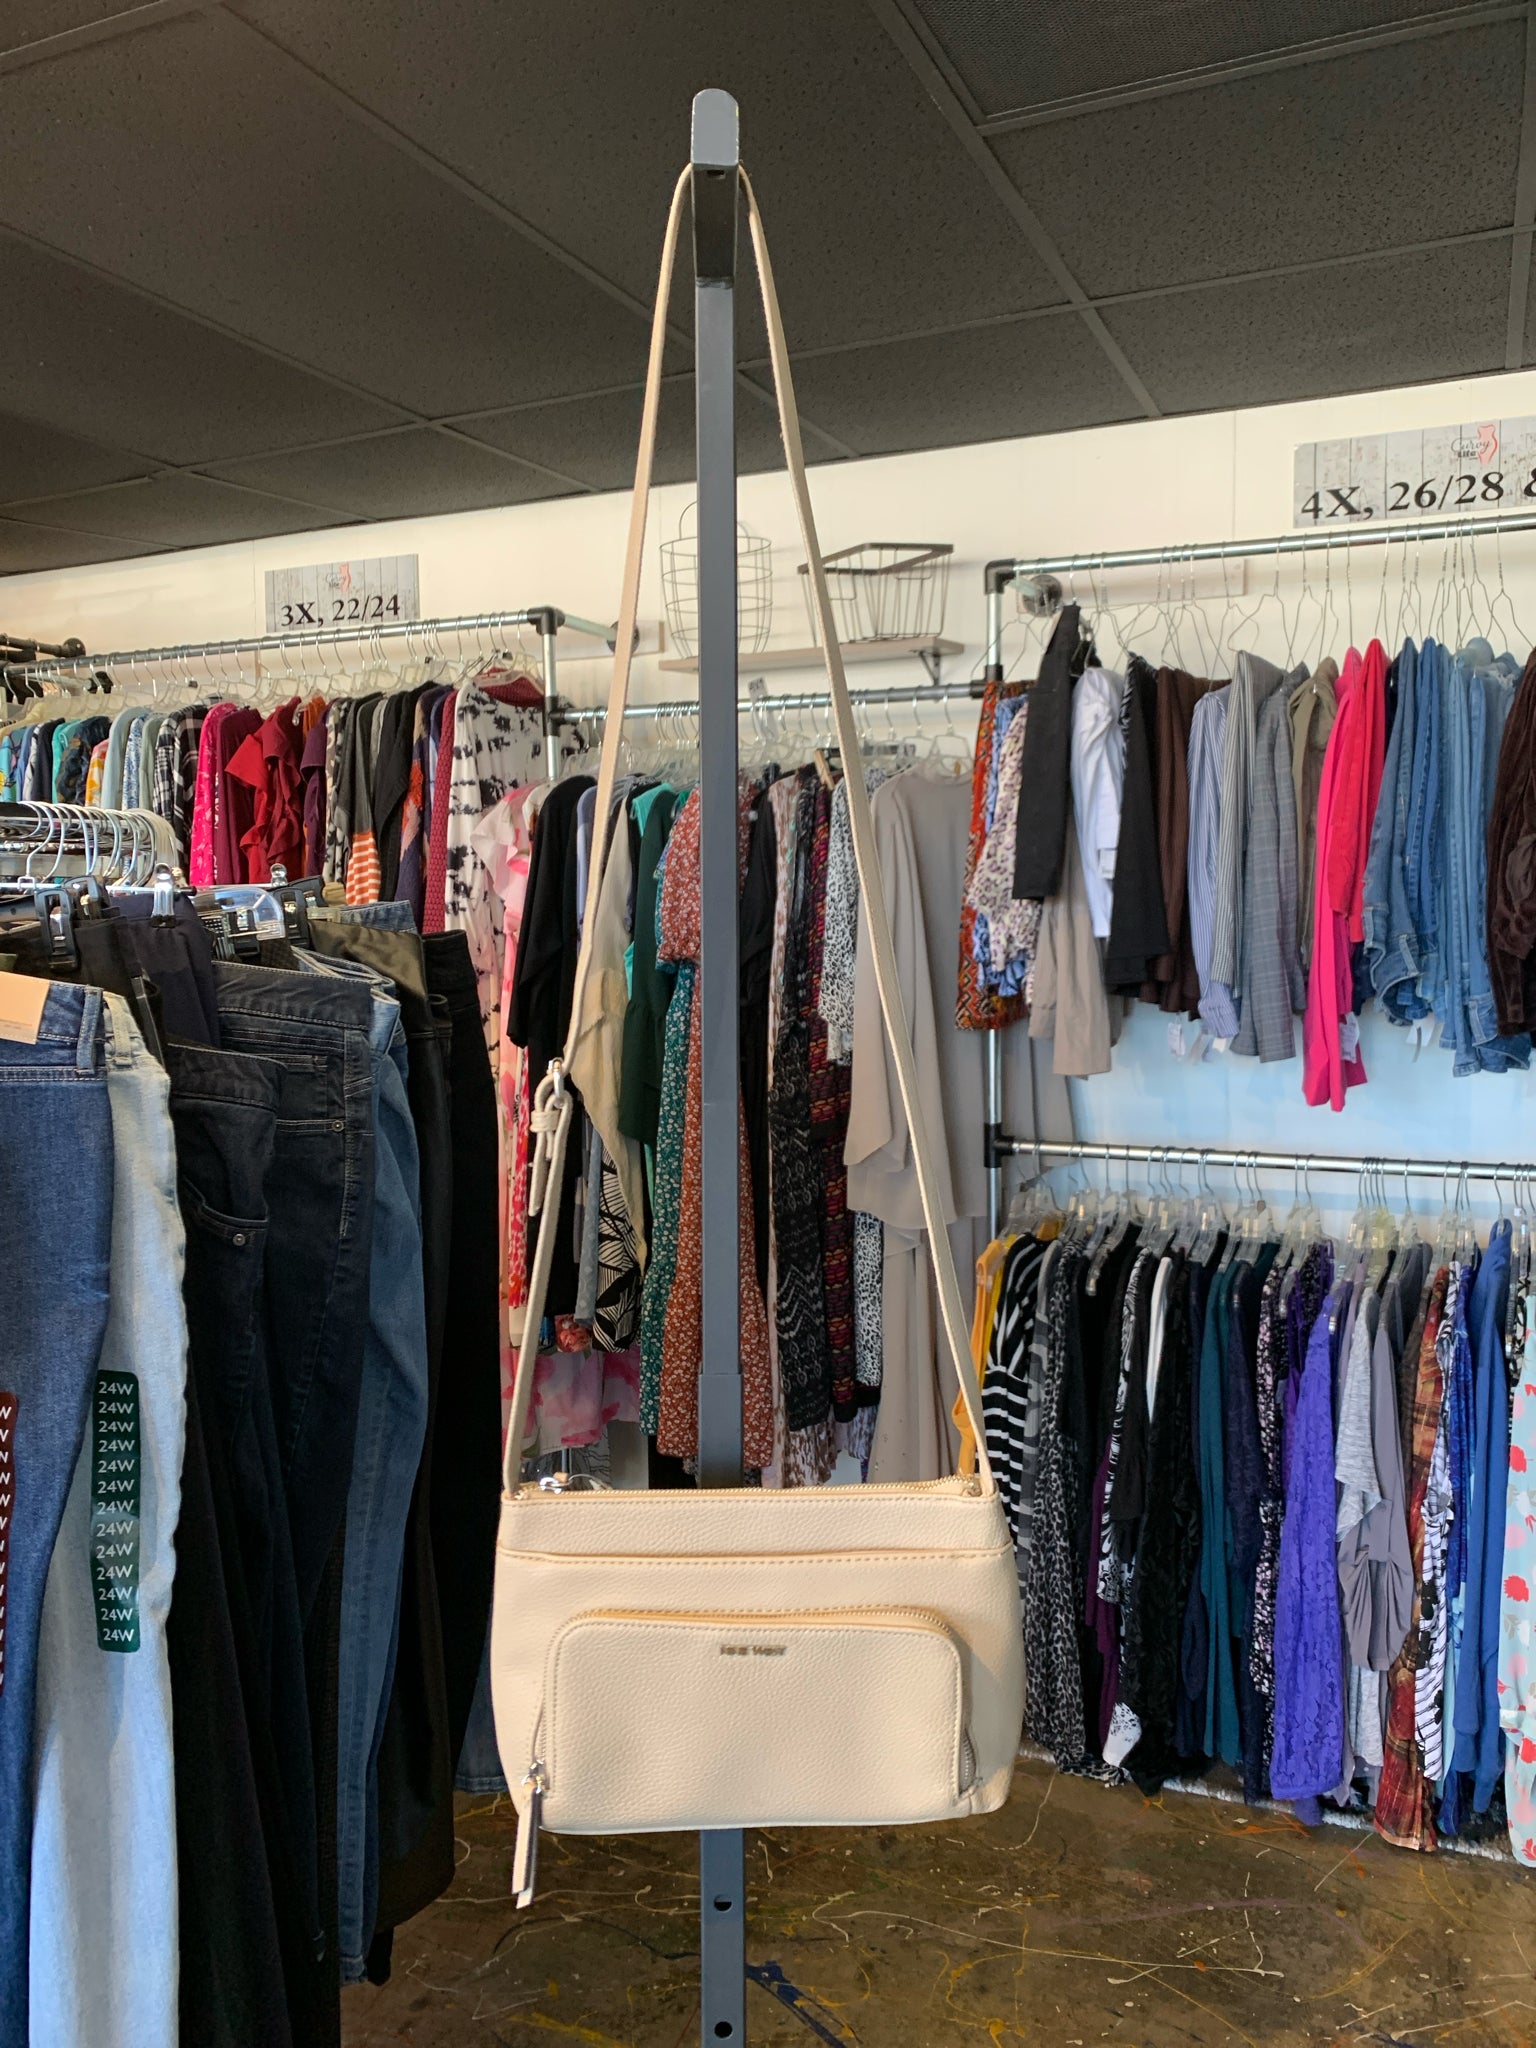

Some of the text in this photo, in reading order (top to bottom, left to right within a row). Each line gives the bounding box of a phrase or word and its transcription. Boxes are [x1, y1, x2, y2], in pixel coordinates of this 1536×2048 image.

[1301, 485, 1374, 520] 4X,
[1388, 471, 1504, 511] 26/28
[281, 594, 400, 628] 3X, 22/24
[99, 1381, 134, 1395] 24W
[98, 1401, 134, 1414] 24W
[98, 1420, 134, 1433] 24W
[98, 1439, 135, 1452] 24W
[97, 1458, 135, 1473] 24W
[97, 1479, 135, 1493] 24W
[97, 1499, 134, 1514] 24W
[96, 1520, 133, 1537] 24W
[96, 1542, 133, 1558] 24W
[96, 1564, 133, 1580] 24W
[98, 1586, 133, 1601] 24W
[101, 1607, 133, 1621] 24W
[103, 1628, 135, 1642] 24W
